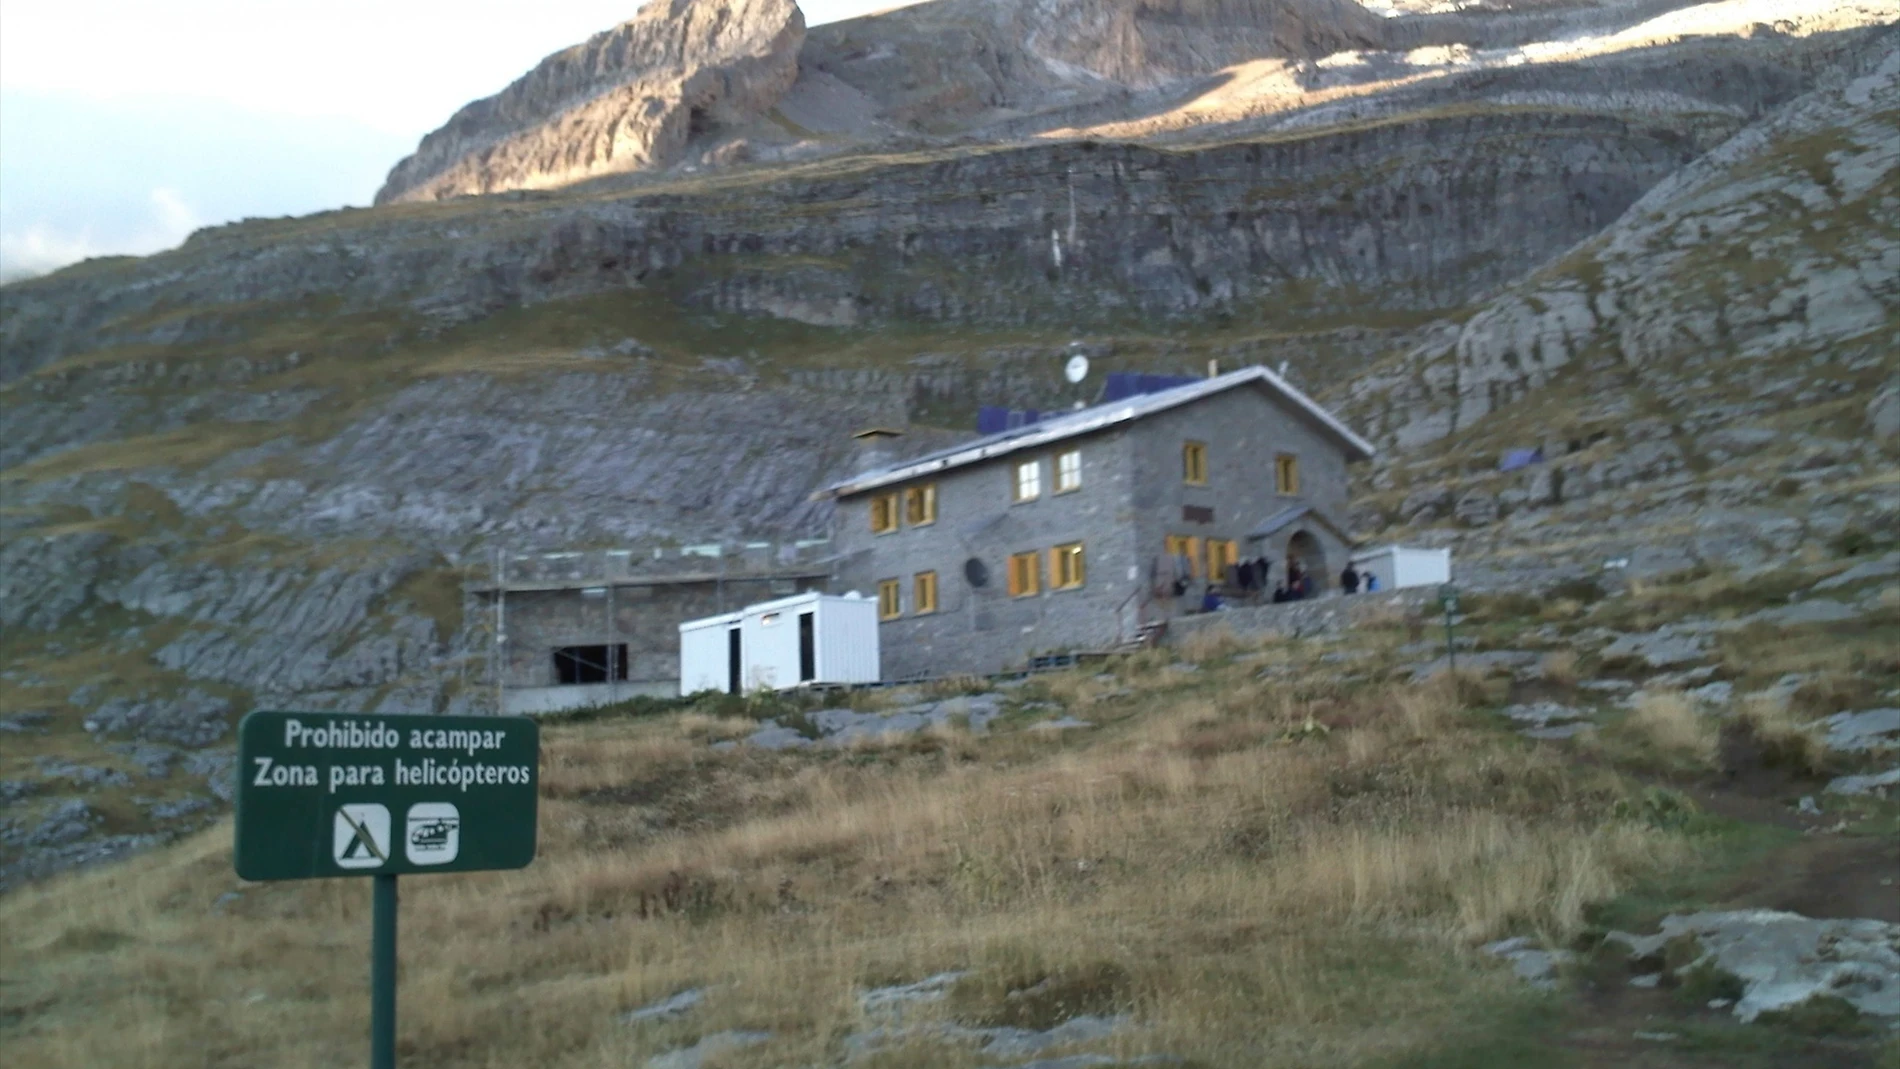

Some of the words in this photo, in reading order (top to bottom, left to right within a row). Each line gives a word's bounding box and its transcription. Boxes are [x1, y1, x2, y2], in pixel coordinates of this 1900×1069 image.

[284, 719, 400, 748] Prohibido
[410, 729, 506, 756] acampar
[253, 757, 318, 787] Zona
[329, 765, 385, 793] para
[395, 758, 530, 791] helicópteros
